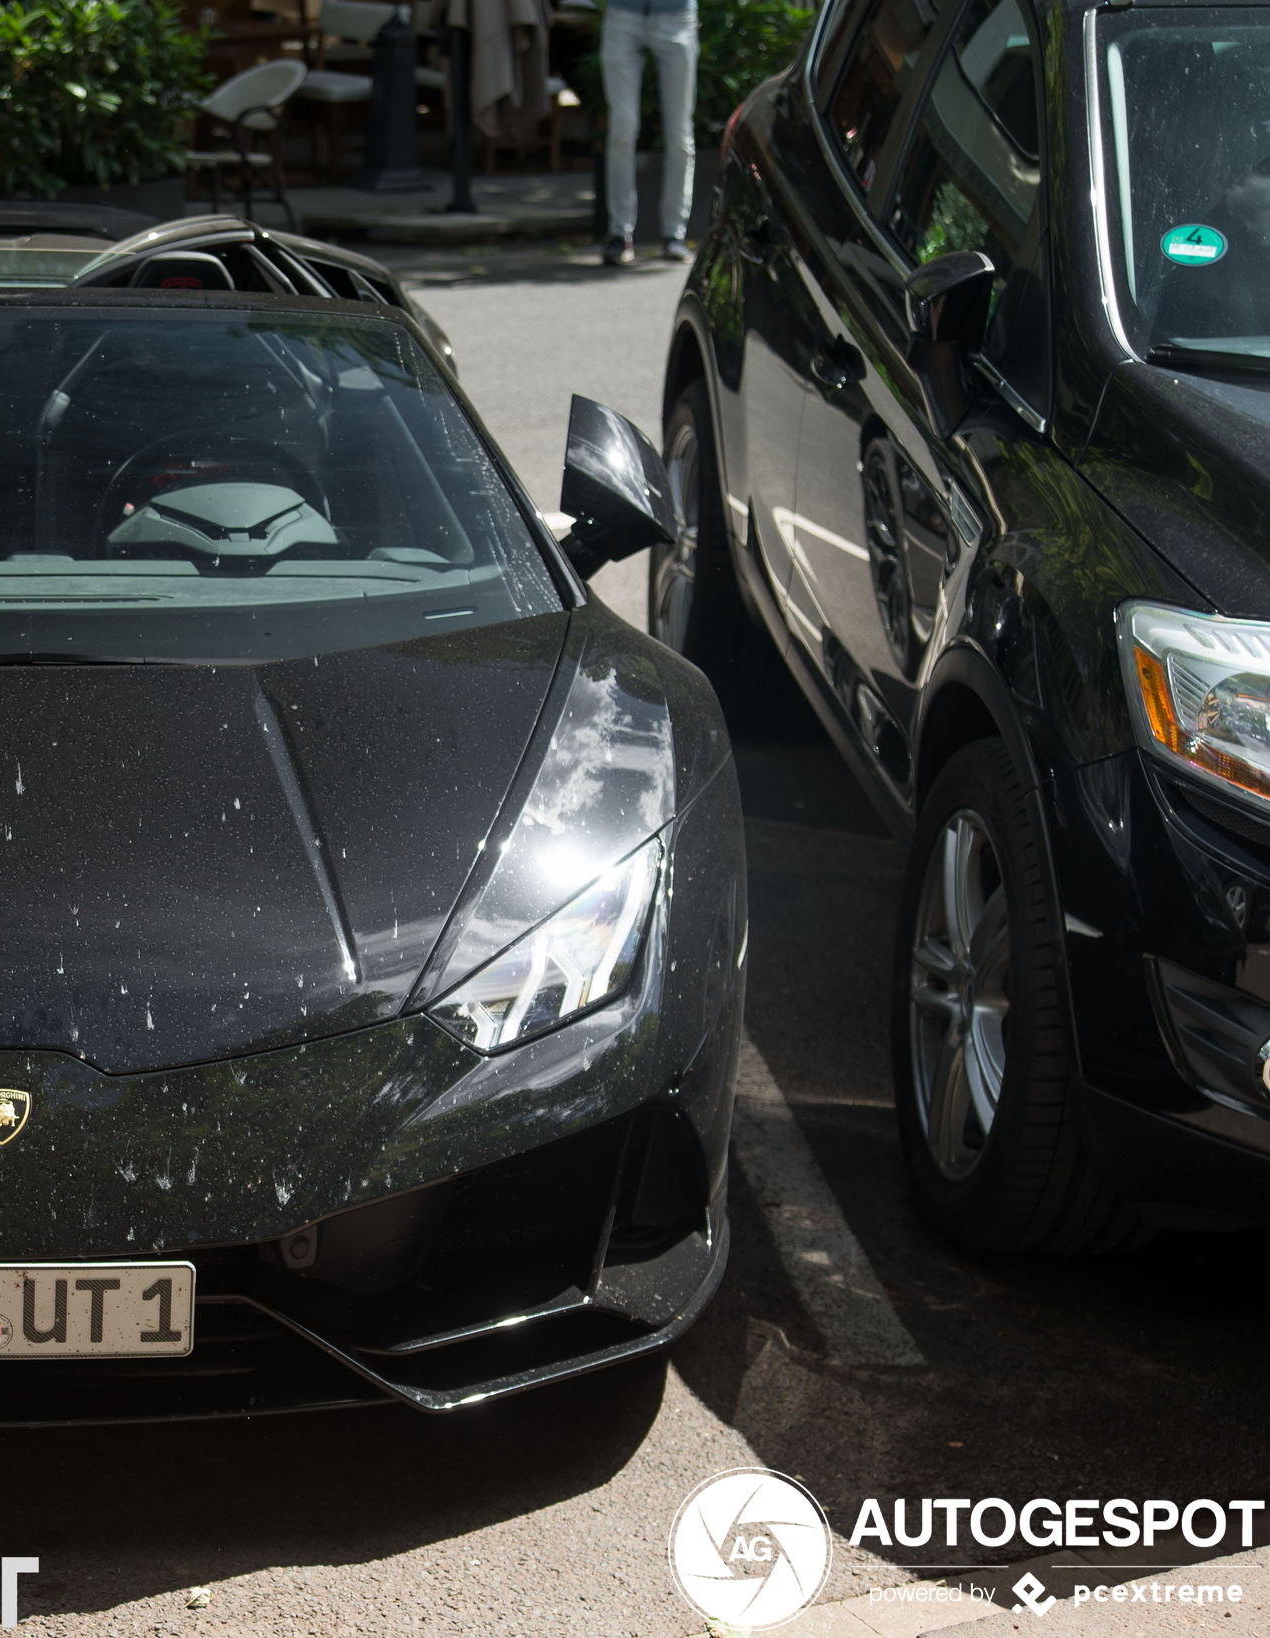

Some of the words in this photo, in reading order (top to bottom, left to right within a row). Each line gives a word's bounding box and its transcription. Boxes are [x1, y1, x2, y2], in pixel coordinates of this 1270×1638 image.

[1186, 228, 1203, 244] 4
[22, 1278, 121, 1344] UT
[140, 1278, 182, 1343] 1
